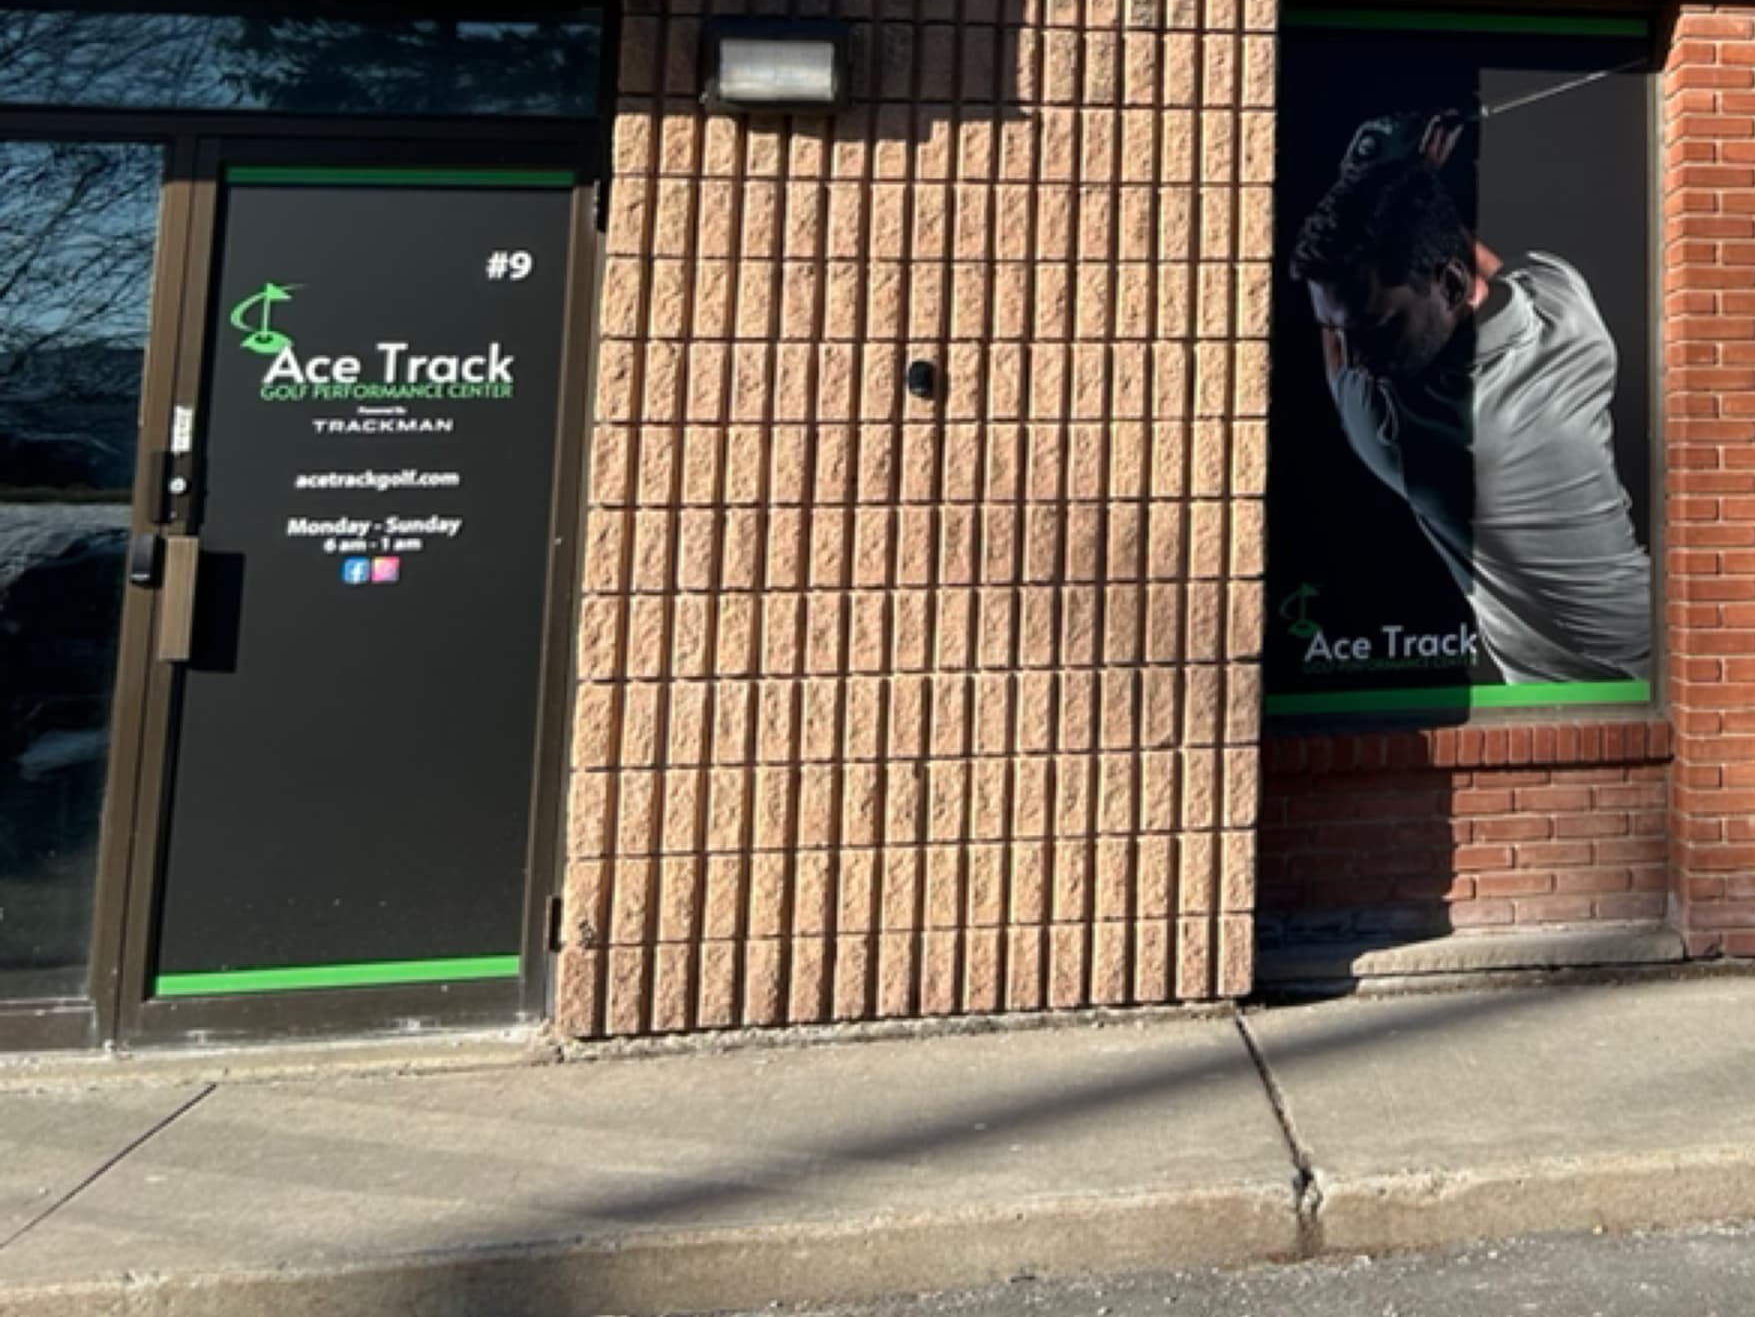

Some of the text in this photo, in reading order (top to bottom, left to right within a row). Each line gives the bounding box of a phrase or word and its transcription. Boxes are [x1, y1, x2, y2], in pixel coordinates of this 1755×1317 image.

[486, 250, 532, 280] #9
[263, 343, 514, 384] Ace Track
[260, 384, 514, 401] GOLF PERFORMANCE CENTER
[312, 418, 454, 433] TRACKMAN
[295, 468, 461, 492] acetrackgolf.com
[287, 515, 370, 537] Monday
[384, 514, 462, 537] Sunday
[1304, 622, 1477, 663] Ace Track
